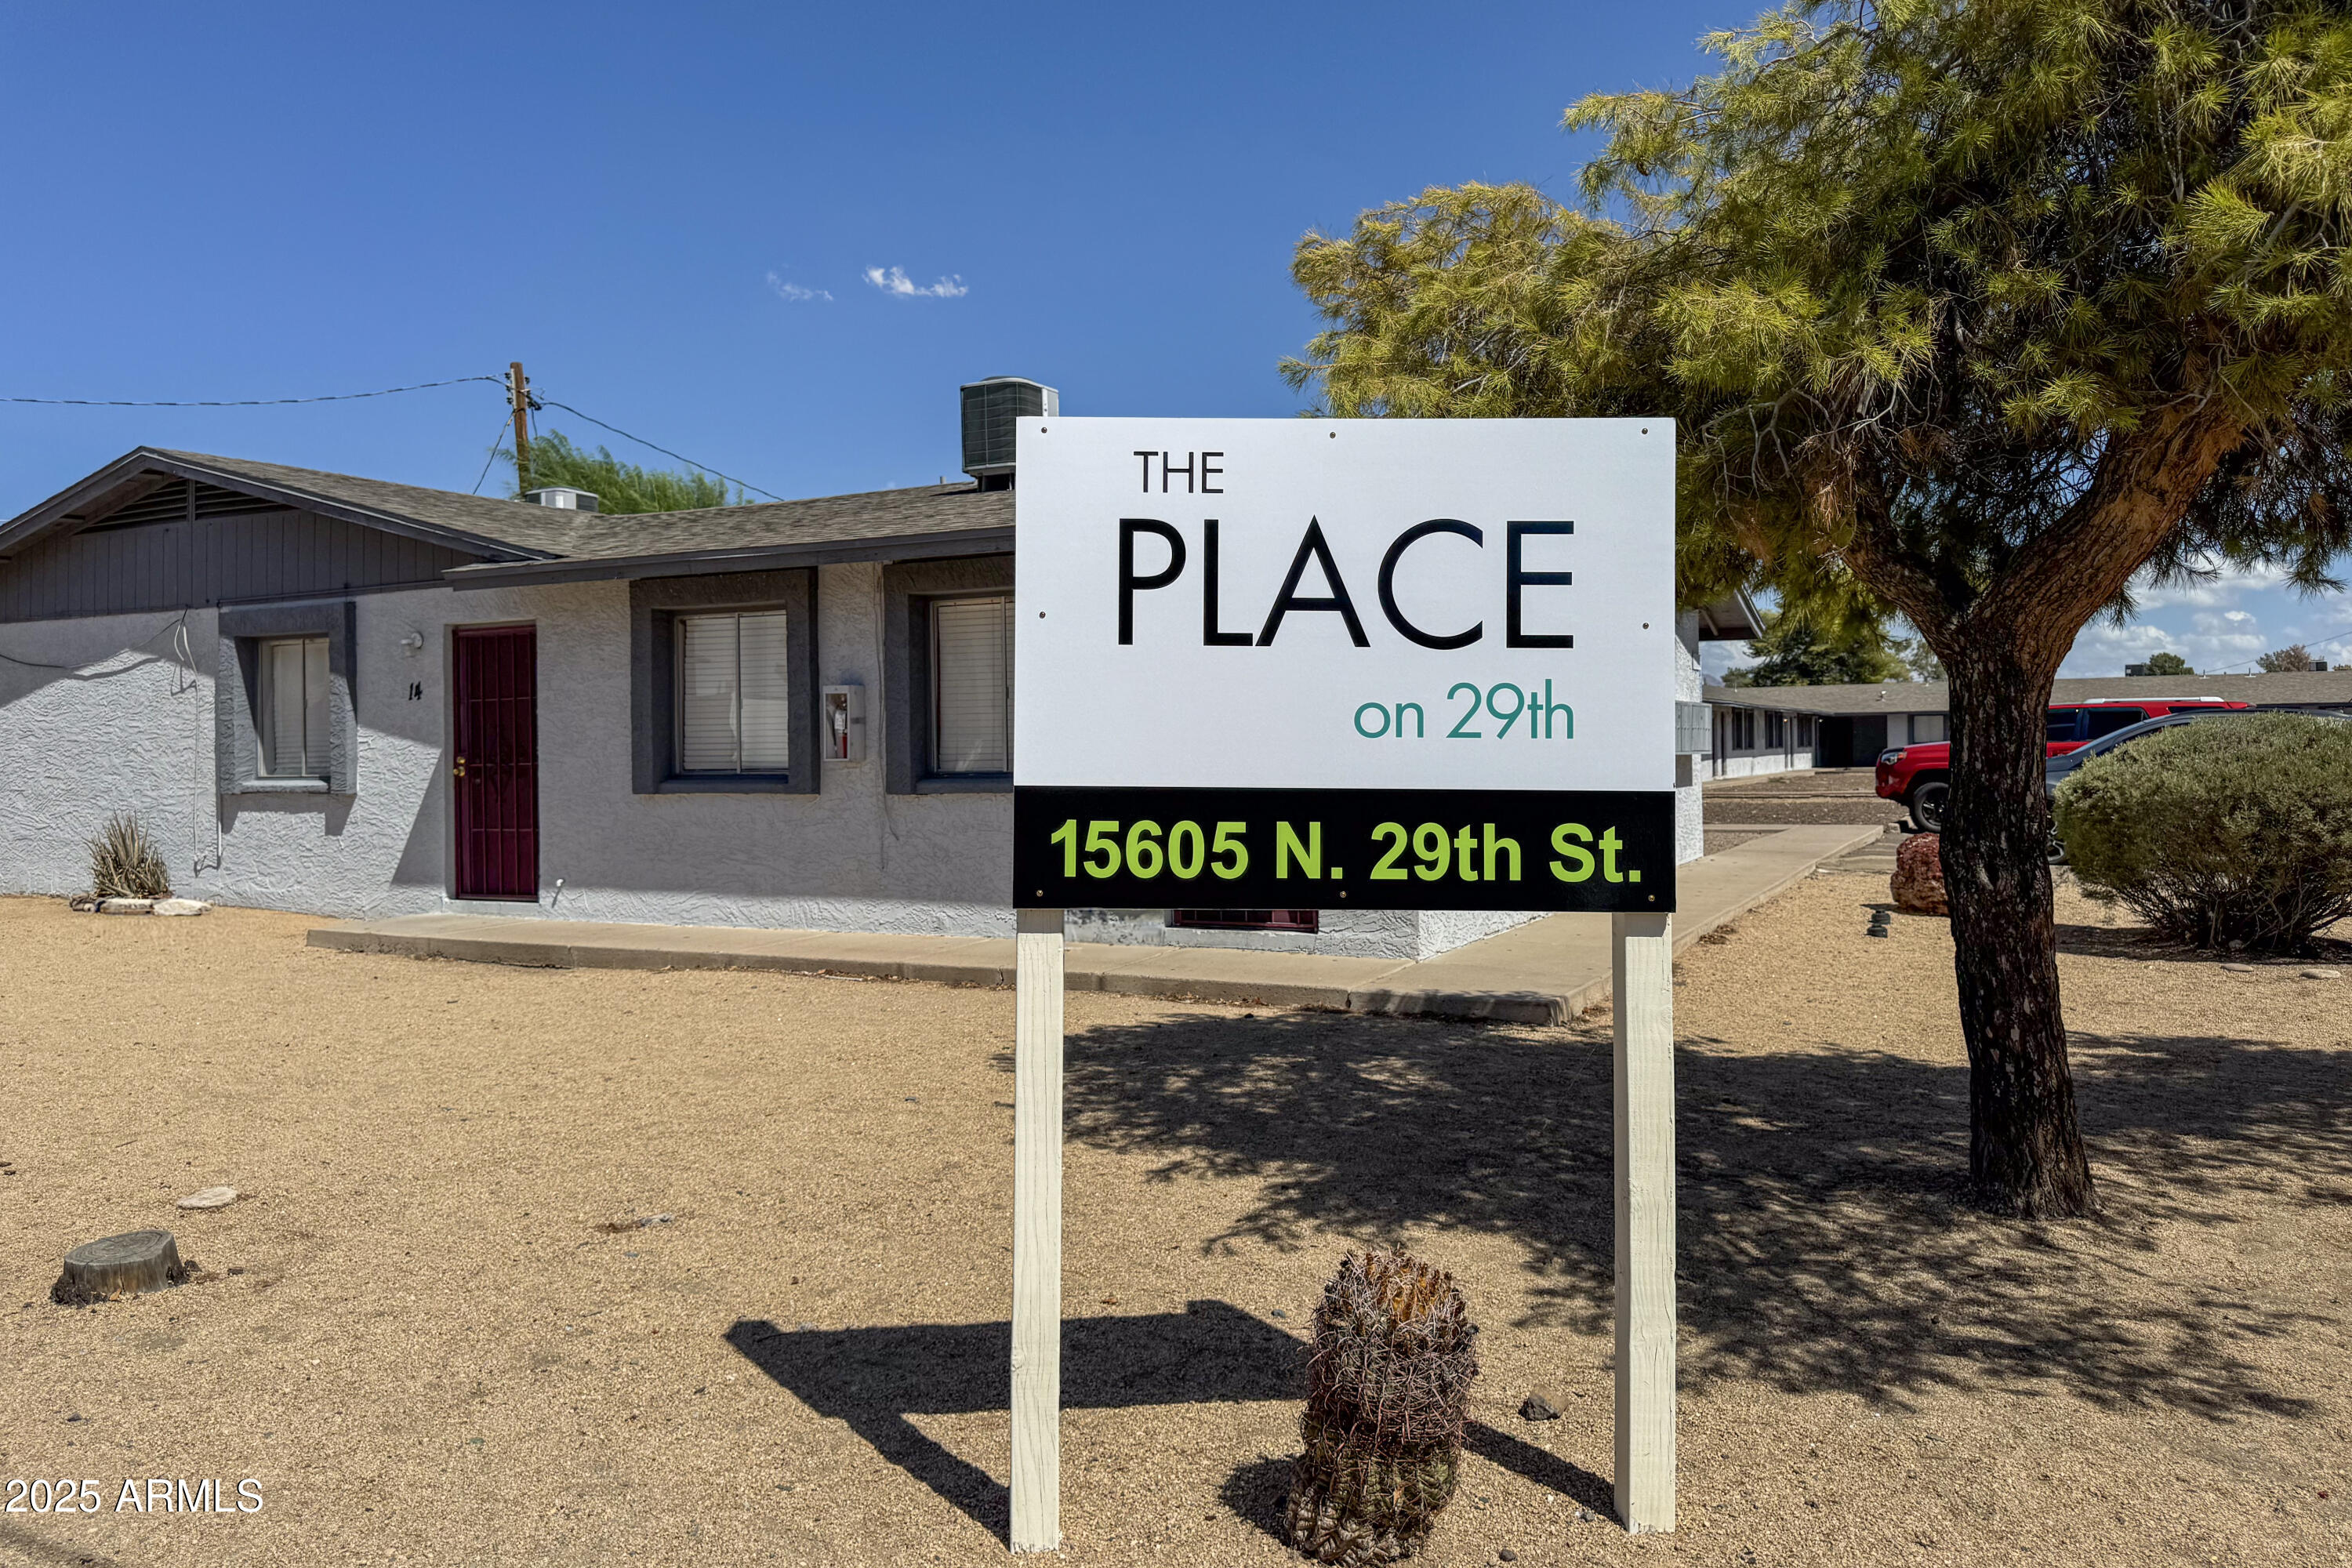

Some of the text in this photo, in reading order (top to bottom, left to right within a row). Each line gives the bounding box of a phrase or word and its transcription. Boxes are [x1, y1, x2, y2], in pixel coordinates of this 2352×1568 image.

[1133, 451, 1225, 494] THE
[1118, 514, 1575, 651] PLACE
[408, 681, 423, 701] 14
[1353, 678, 1574, 740] on 29th
[1051, 818, 1641, 883] 15605 N. 29th St.
